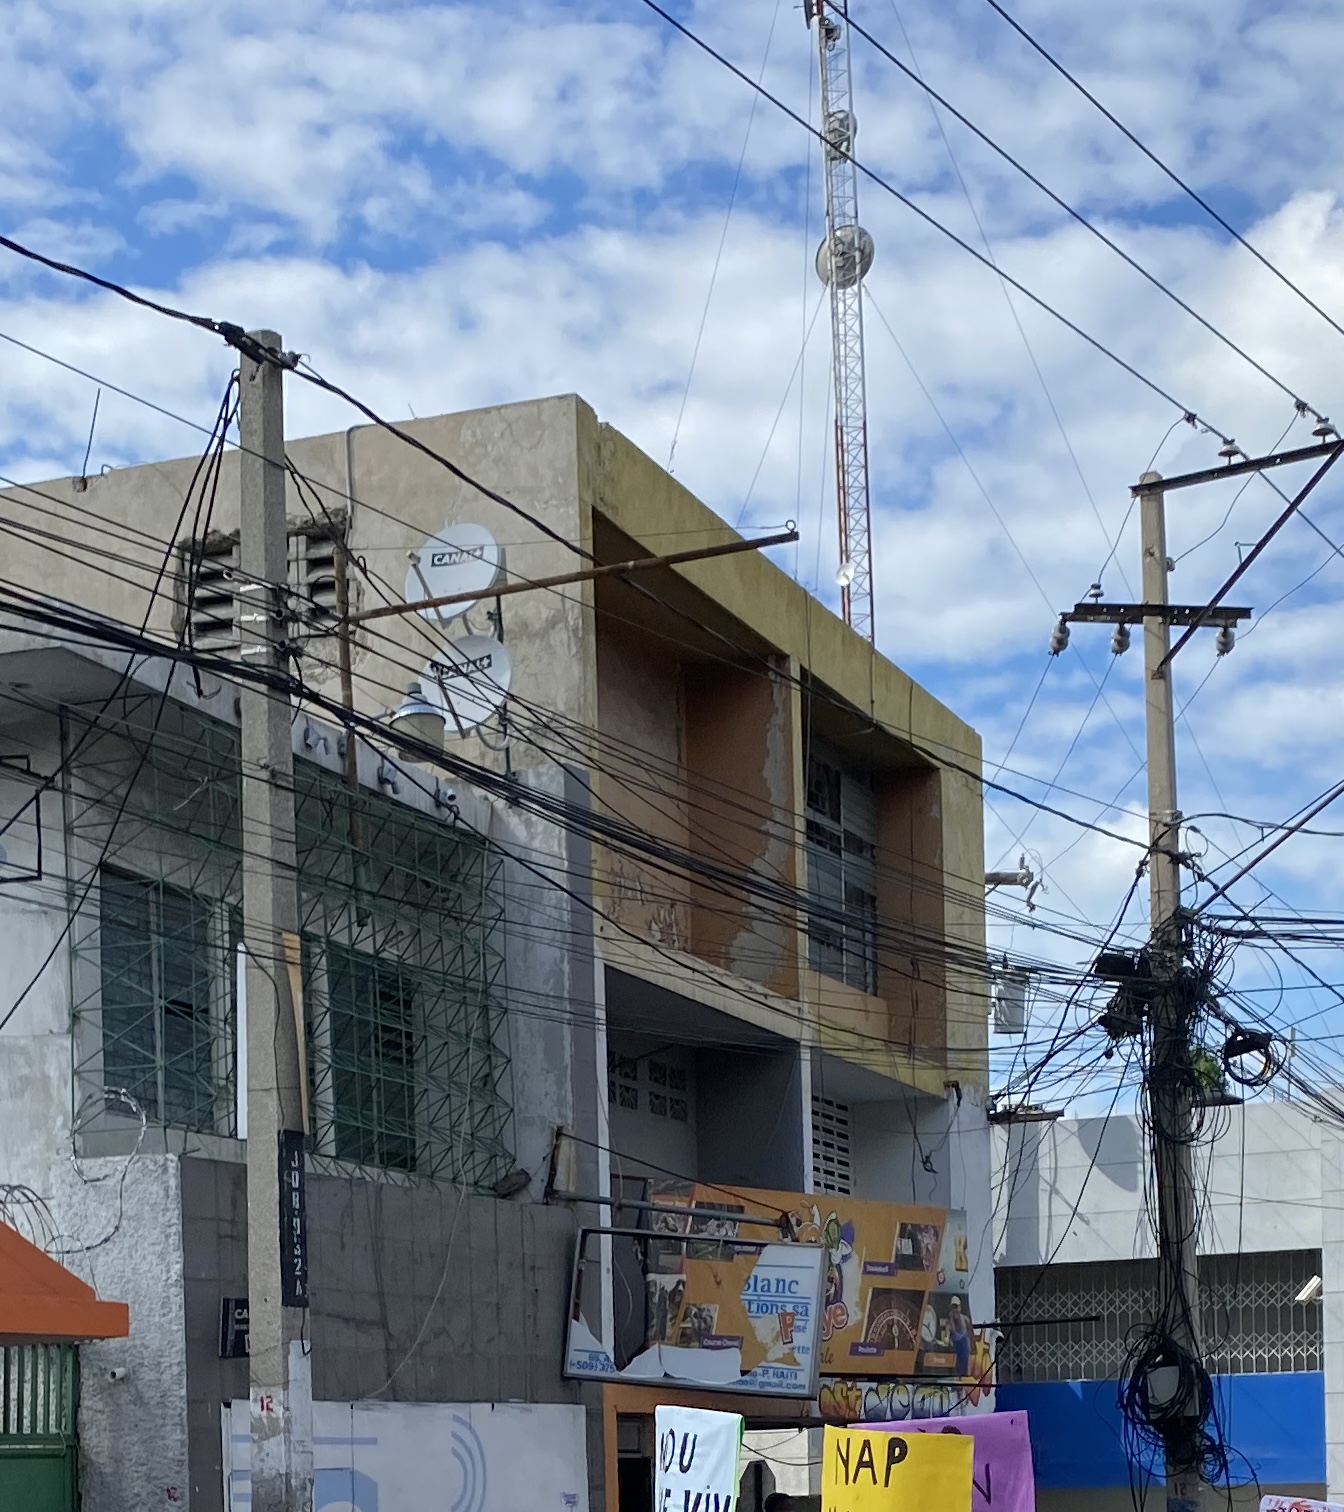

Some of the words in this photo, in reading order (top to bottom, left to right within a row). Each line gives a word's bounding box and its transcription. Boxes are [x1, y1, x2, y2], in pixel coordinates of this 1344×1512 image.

[432, 548, 483, 566] CANAL+
[259, 1394, 274, 1412] 12
[834, 1437, 909, 1489] NAP
[1173, 1482, 1187, 1497] 12
